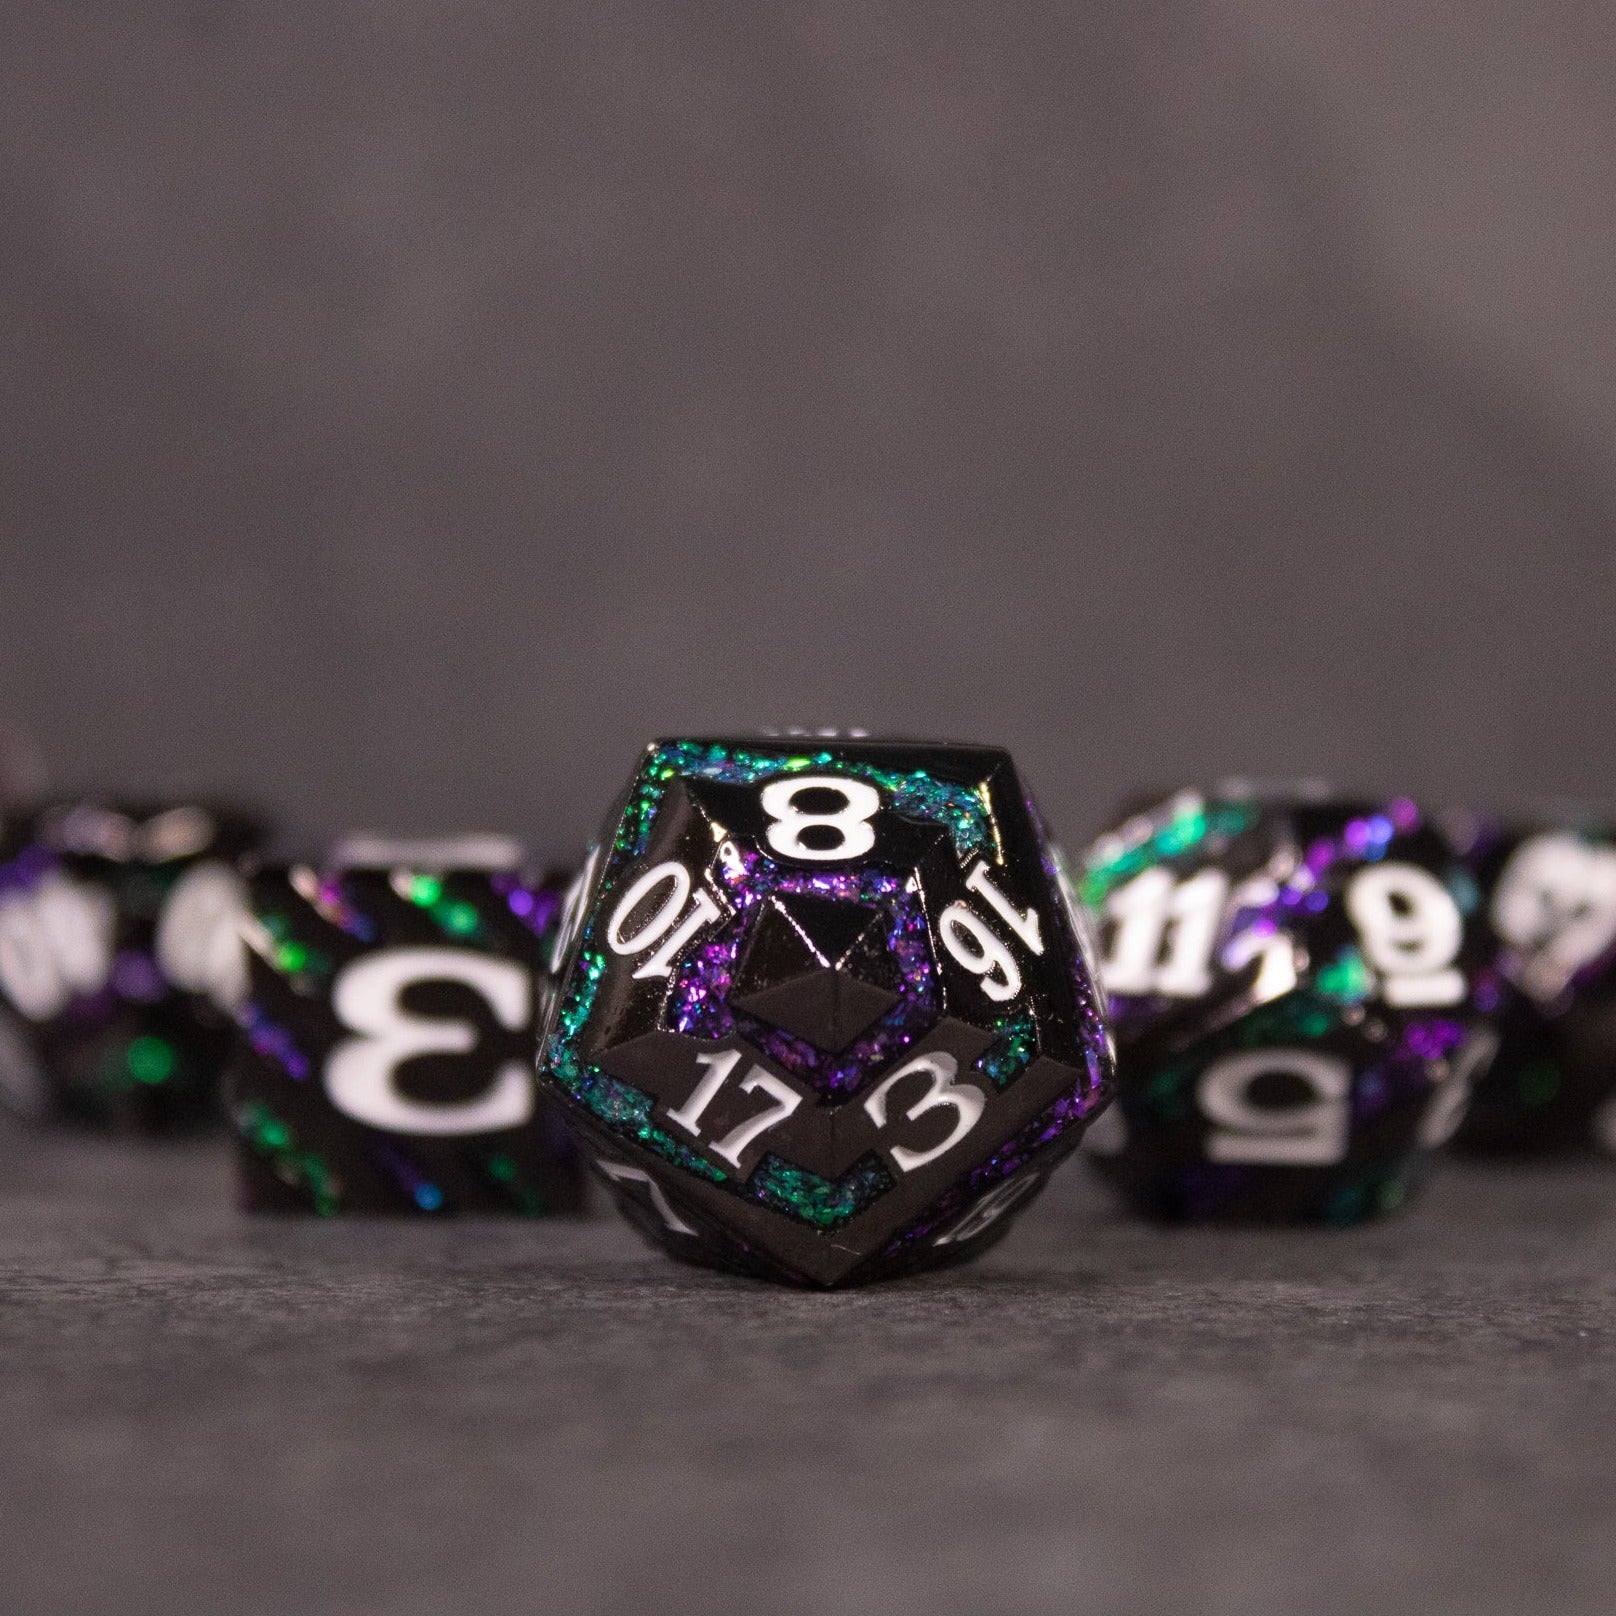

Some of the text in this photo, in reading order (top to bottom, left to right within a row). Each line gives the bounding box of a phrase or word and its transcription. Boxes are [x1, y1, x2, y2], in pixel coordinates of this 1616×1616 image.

[760, 776, 880, 861] 8
[607, 861, 721, 979] 10
[938, 860, 1045, 1002] 16
[1098, 867, 1229, 996] 11
[323, 946, 534, 1135] 3
[666, 1049, 803, 1169] 17
[864, 1052, 986, 1173] 3
